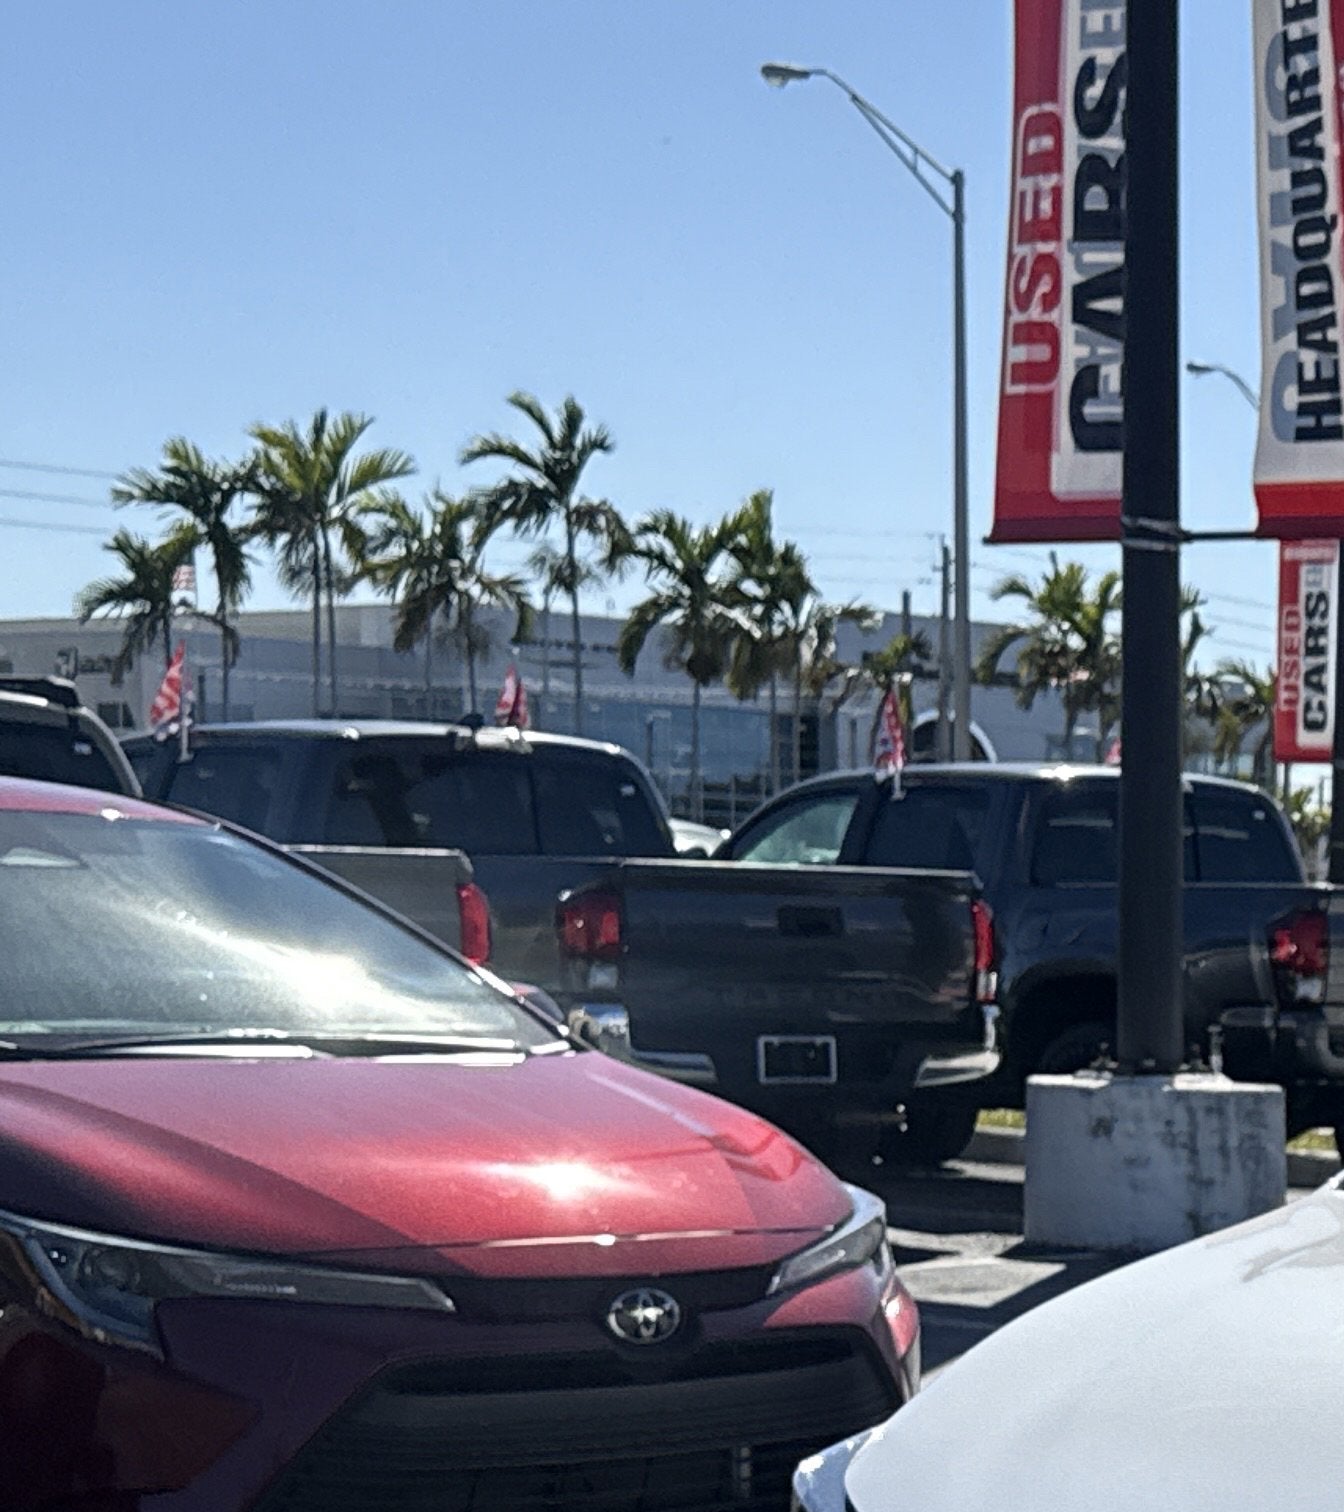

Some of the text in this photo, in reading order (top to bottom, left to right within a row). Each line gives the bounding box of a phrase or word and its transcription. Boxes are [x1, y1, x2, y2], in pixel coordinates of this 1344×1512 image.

[1007, 103, 1063, 393] USED
[1069, 52, 1127, 453] CARS
[1281, 0, 1344, 441] HEADQUARTE
[1282, 604, 1301, 711] USED
[1302, 590, 1330, 733] CARS
